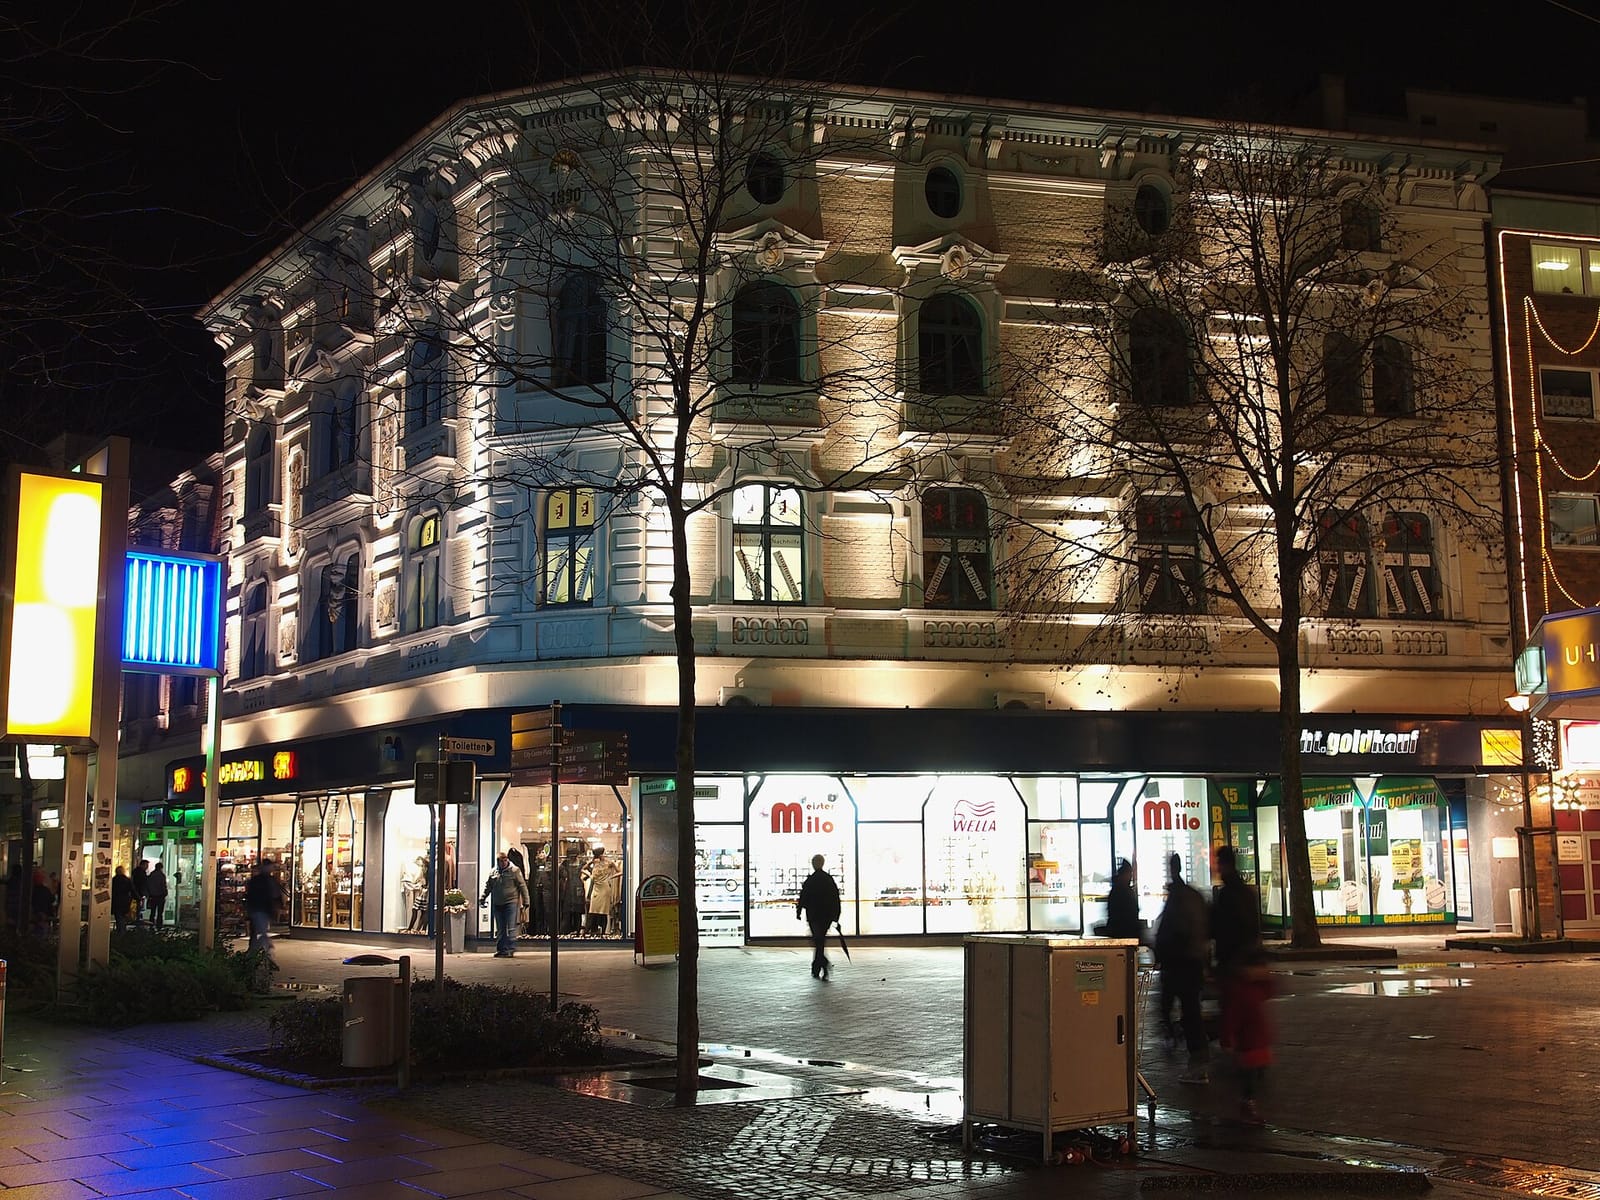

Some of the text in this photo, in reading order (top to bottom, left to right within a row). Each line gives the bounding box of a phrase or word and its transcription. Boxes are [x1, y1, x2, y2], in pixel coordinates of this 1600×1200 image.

[1412, 570, 1431, 612] Nachhilfe
[452, 741, 486, 752] Toiletten
[953, 819, 997, 832] WELLA
